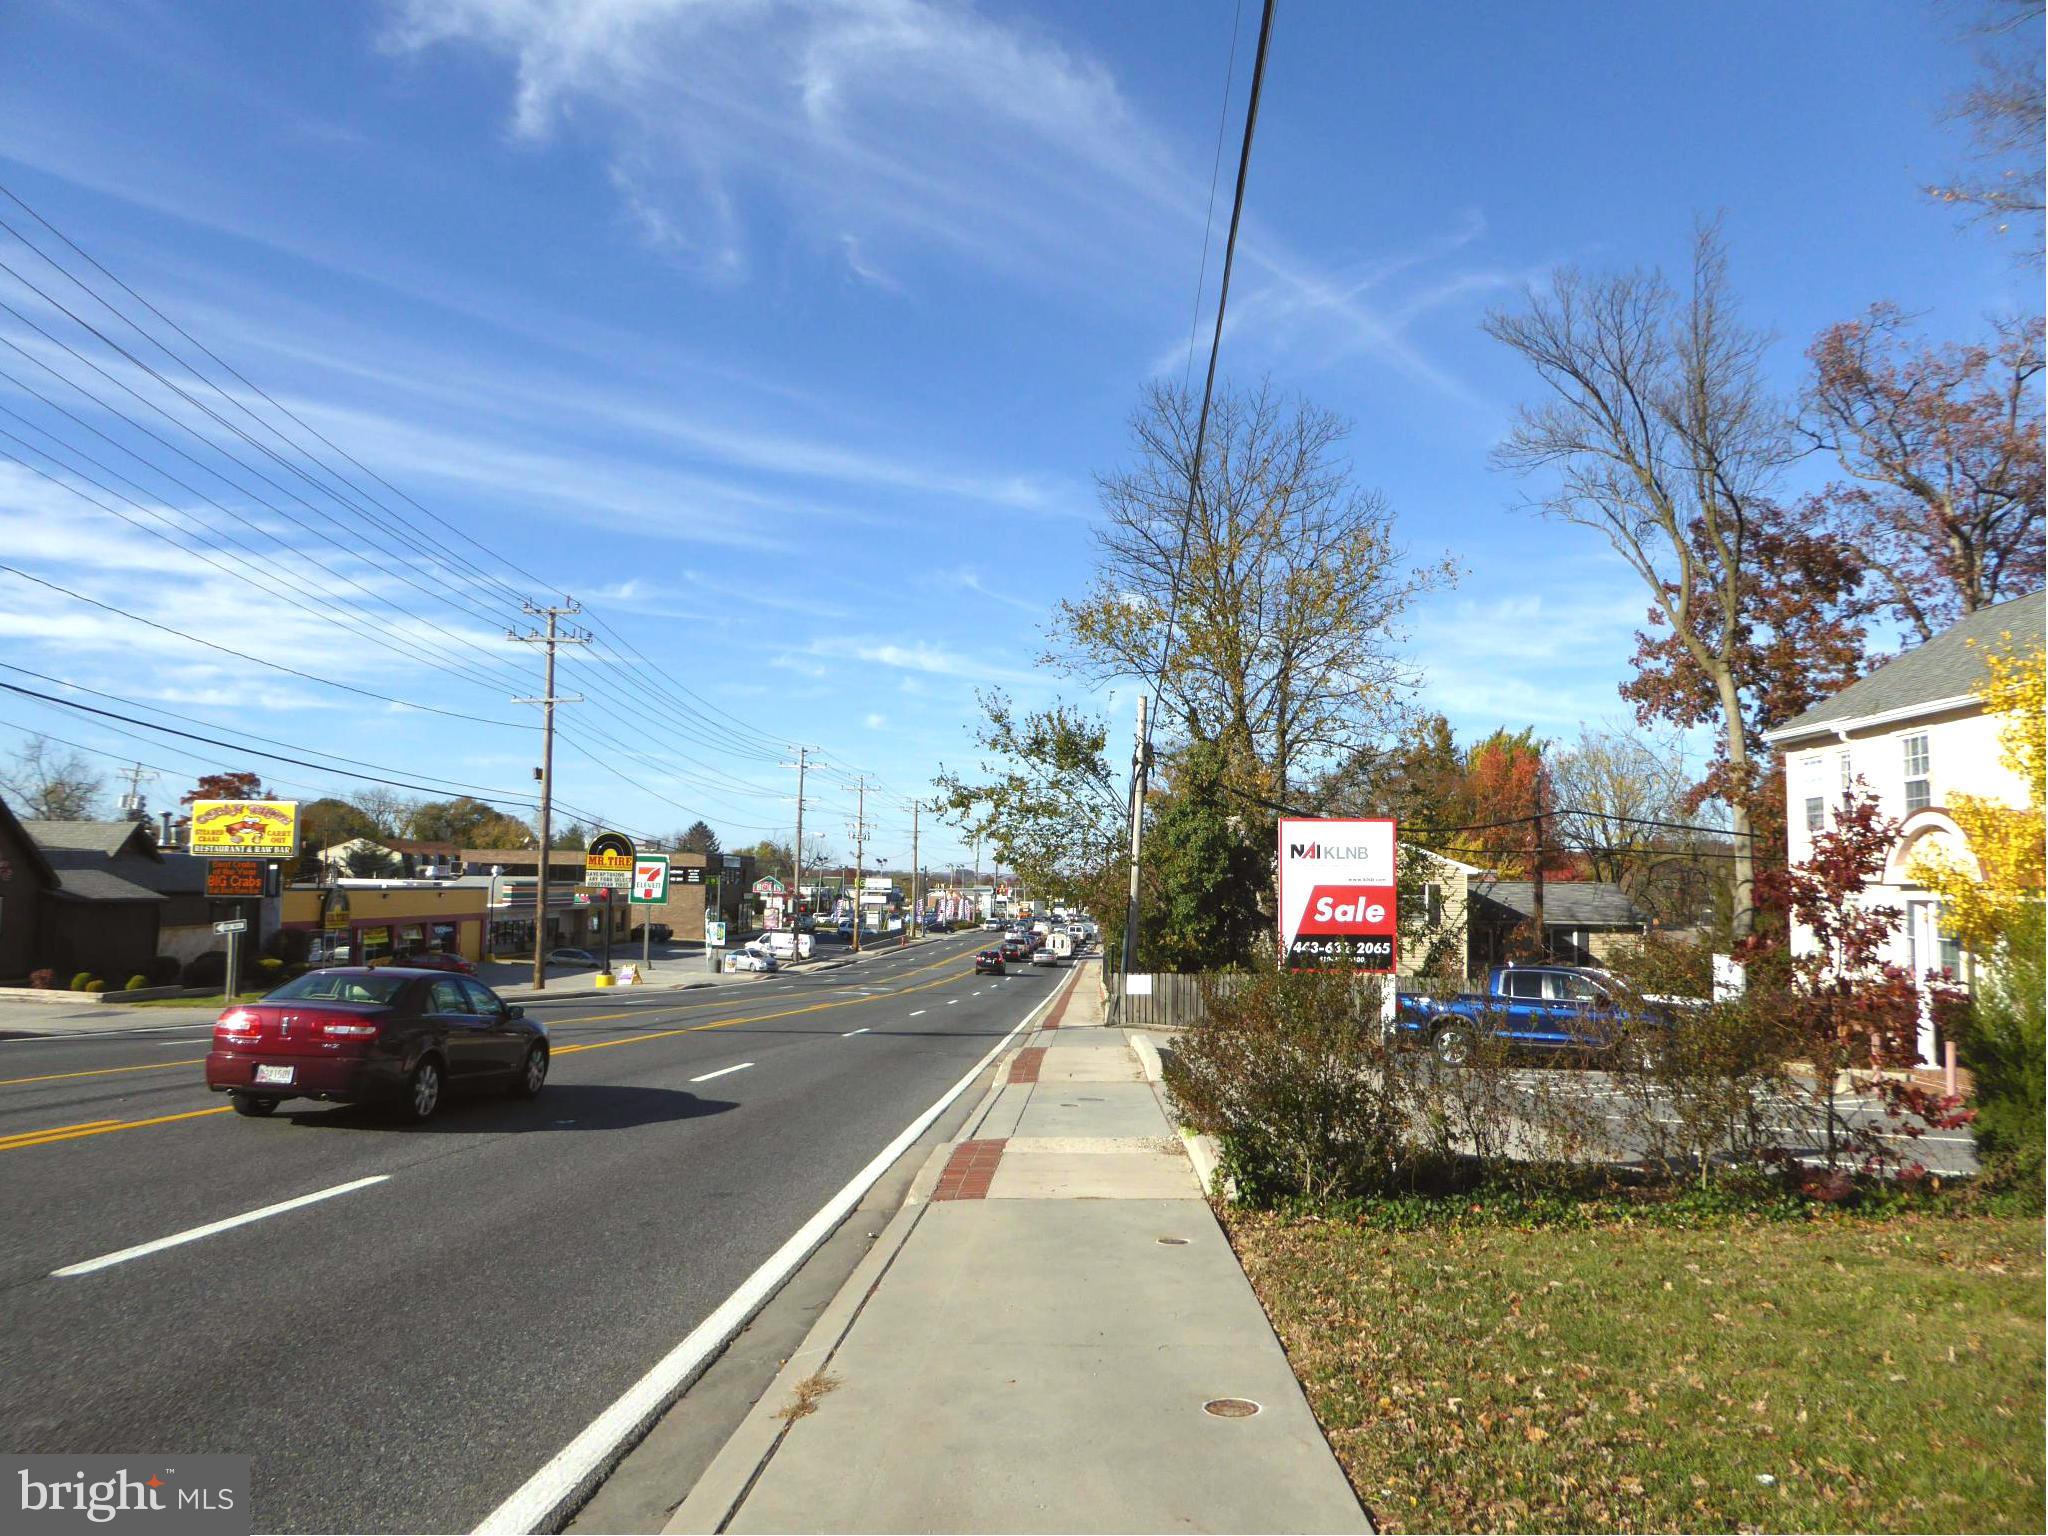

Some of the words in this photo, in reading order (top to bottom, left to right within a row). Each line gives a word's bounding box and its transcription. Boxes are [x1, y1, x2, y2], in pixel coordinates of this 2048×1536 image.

[194, 845, 244, 853] RESTAURANT
[274, 846, 290, 854] BAR
[1290, 841, 1321, 859] NAI
[1324, 846, 1369, 860] KLNB
[608, 857, 633, 867] TIRE
[208, 875, 227, 887] BIG
[230, 875, 262, 887] Crabs
[1314, 895, 1386, 923] Sale
